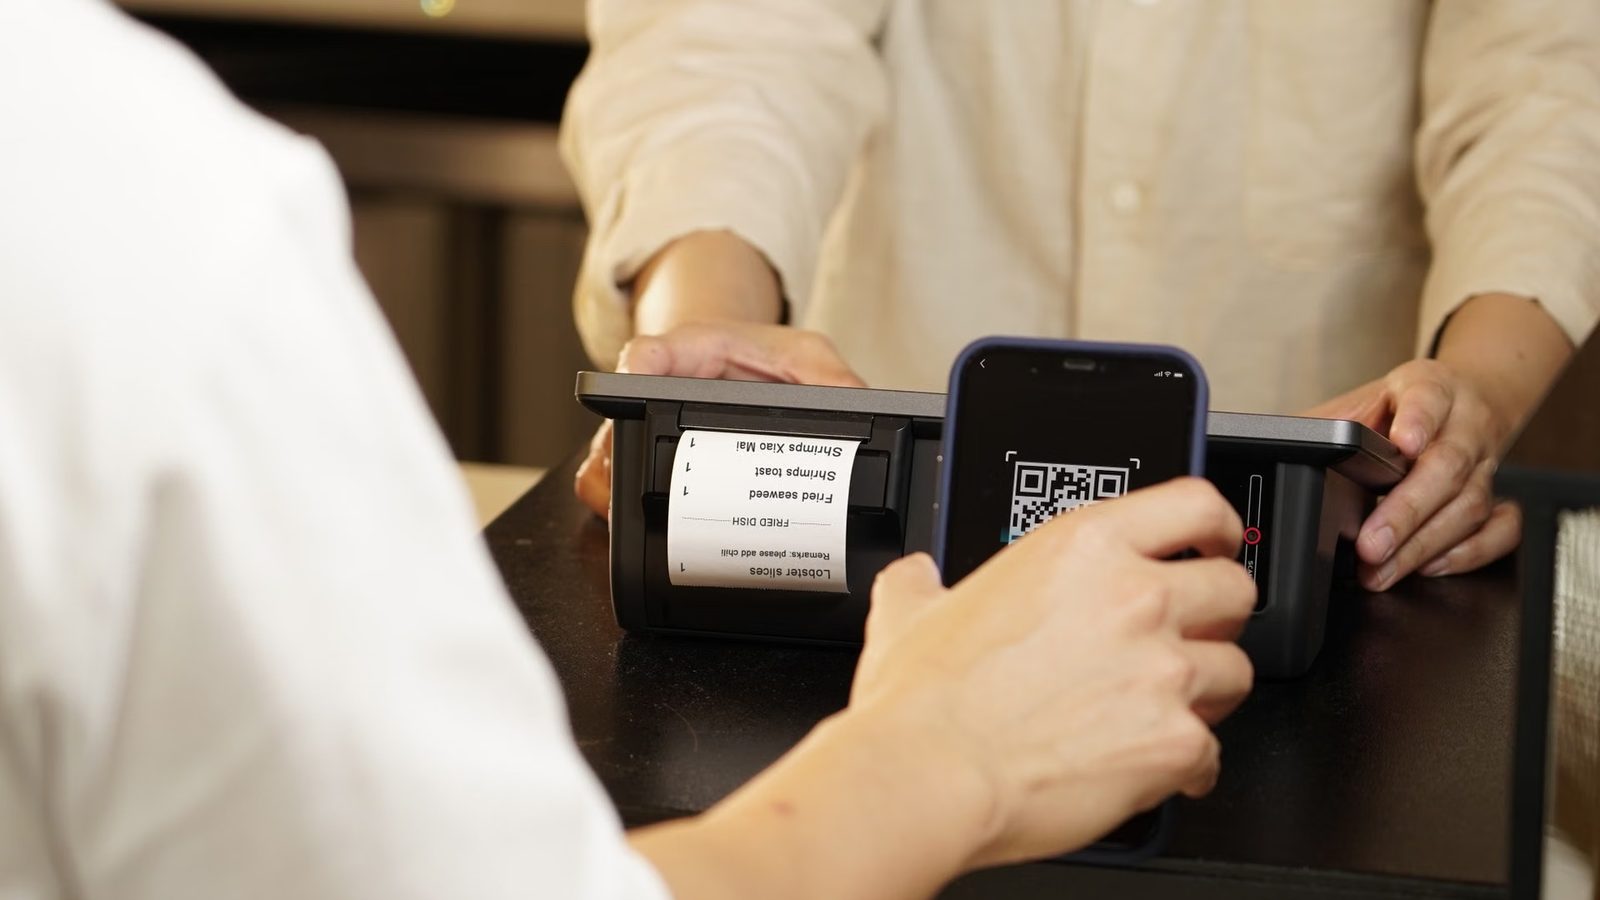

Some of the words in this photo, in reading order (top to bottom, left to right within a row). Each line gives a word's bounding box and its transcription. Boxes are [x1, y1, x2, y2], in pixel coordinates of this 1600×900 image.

[690, 437, 696, 448] 1
[736, 441, 756, 452] Mai
[759, 442, 784, 454] Xiao
[789, 442, 842, 457] Shrimps
[685, 462, 691, 472] 1
[755, 466, 782, 477] toast
[786, 466, 836, 481] Shrimps
[683, 486, 689, 496] 1
[749, 489, 798, 500] seaweed
[802, 492, 833, 504] Fried
[732, 516, 756, 526] DISH
[759, 517, 789, 527] FRIED
[741, 549, 757, 557] add
[759, 549, 787, 559] please
[790, 551, 830, 560] Remarks:
[680, 562, 686, 572] 1
[750, 567, 783, 577] slices
[786, 568, 831, 579] Lobster
